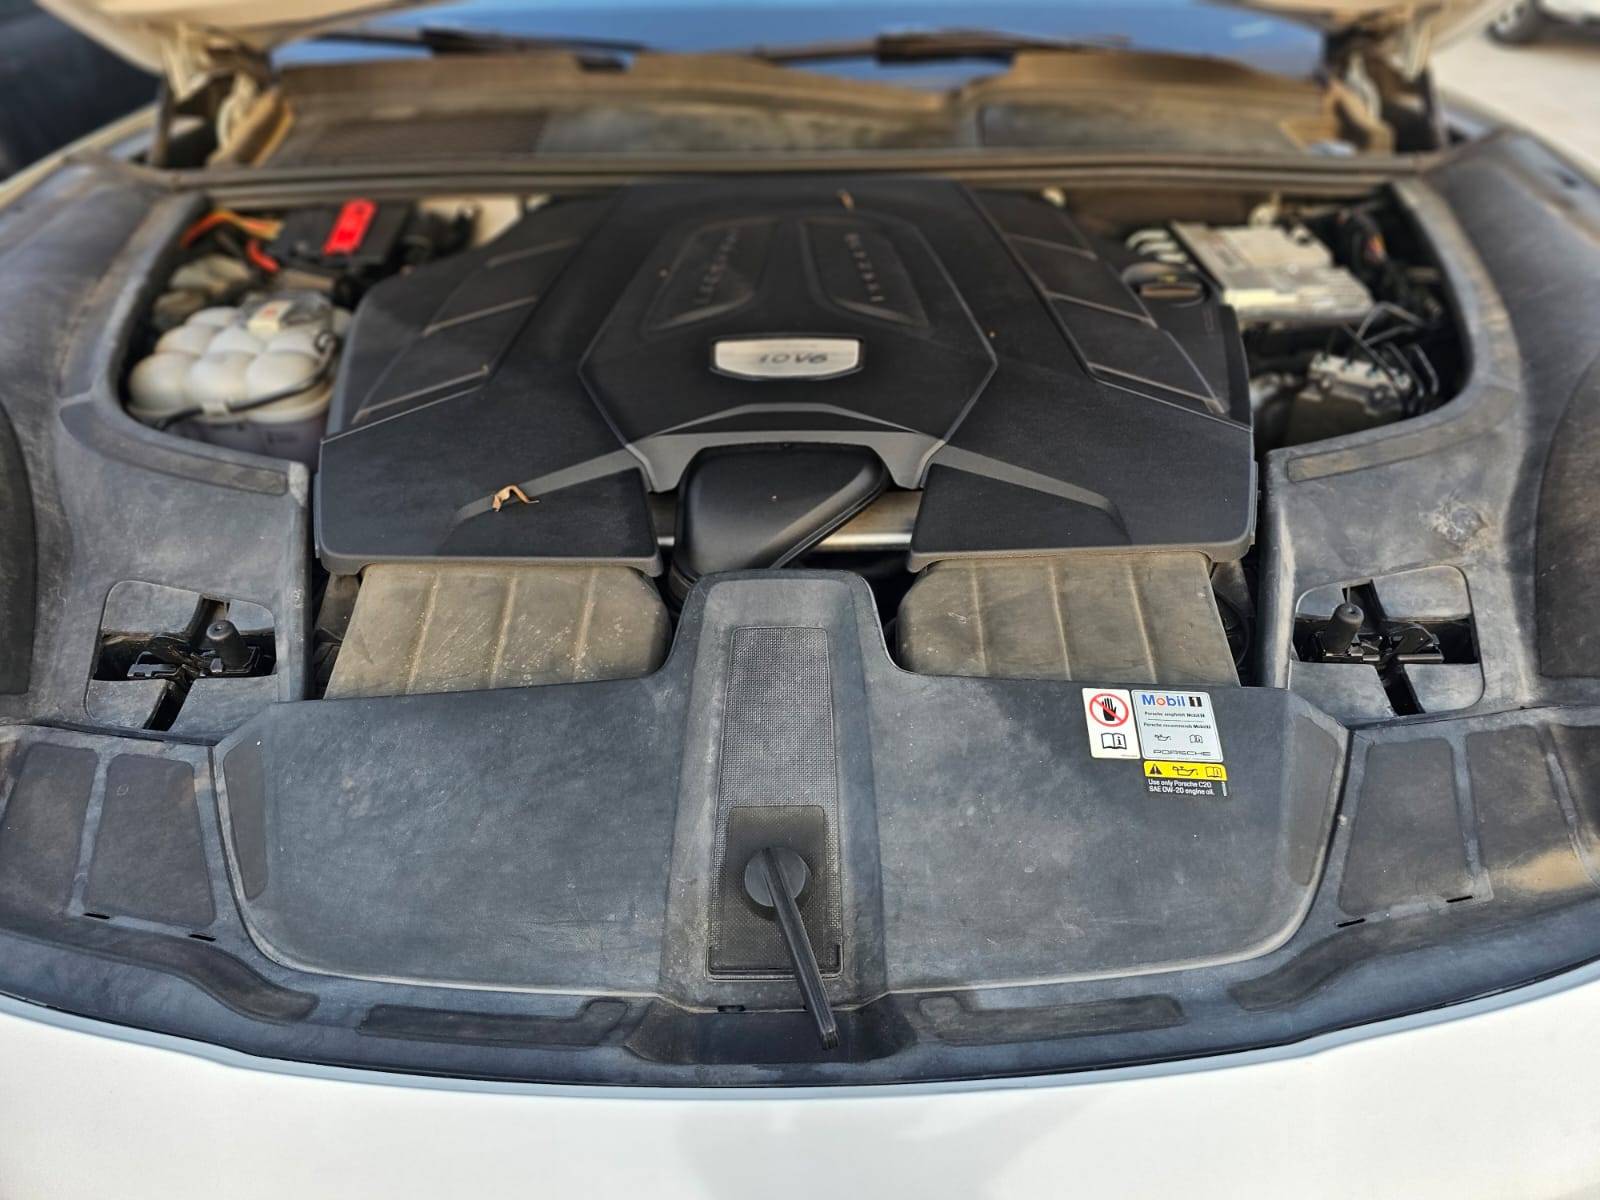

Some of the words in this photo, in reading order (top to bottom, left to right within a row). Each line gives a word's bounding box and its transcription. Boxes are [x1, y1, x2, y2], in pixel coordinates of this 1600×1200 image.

[1141, 694, 1186, 707] Mobil
[1189, 696, 1202, 707] 1
[1185, 788, 1205, 796] engine
